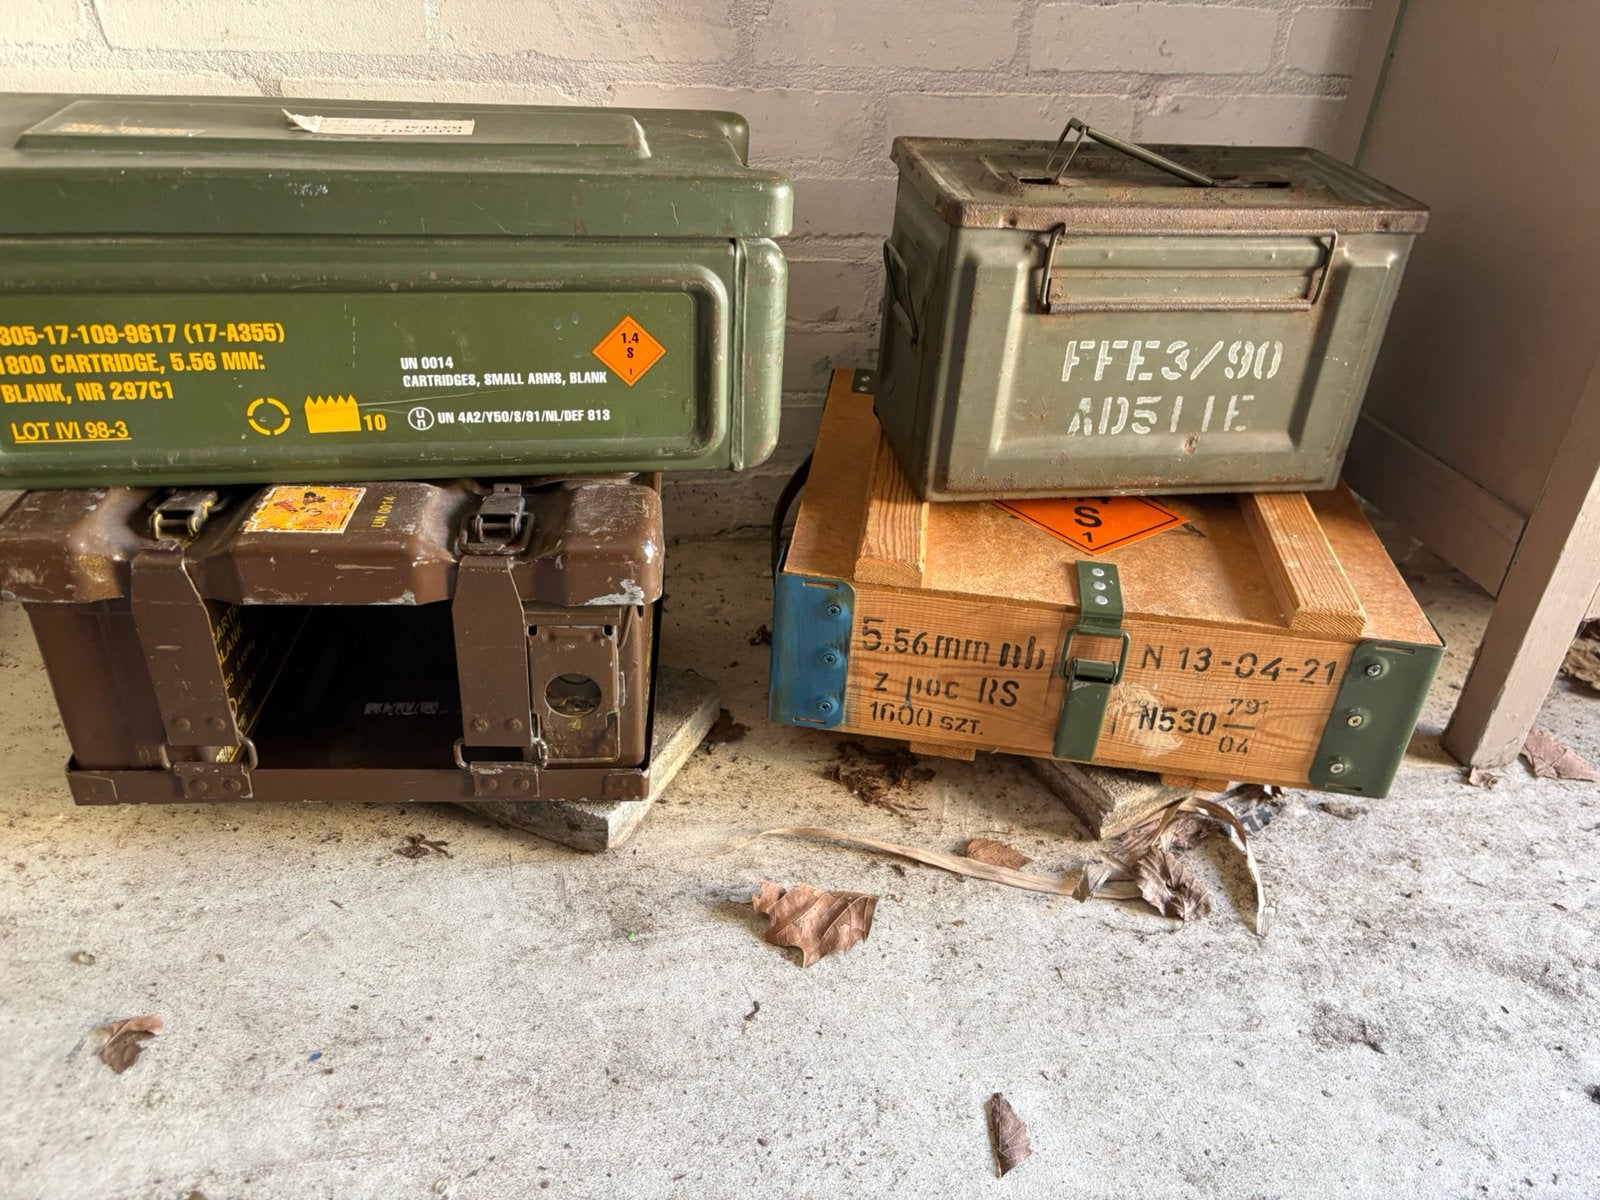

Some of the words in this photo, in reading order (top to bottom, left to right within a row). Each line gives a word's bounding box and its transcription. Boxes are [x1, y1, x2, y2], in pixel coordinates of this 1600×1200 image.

[184, 322, 285, 344] (17-A355)
[621, 332, 639, 344] 1.4
[50, 353, 165, 375] CARTRIDGE,
[169, 351, 217, 372] 5.56
[221, 351, 265, 370] MM:
[400, 357, 418, 370] UN
[421, 356, 454, 369] 0014
[626, 347, 634, 359] S
[1061, 340, 1284, 382] FFE3/90
[403, 373, 480, 388] CARTRIDGES,
[483, 373, 525, 386] SMALL
[528, 372, 566, 387] ARMS,
[569, 371, 607, 384] BLANK
[0, 382, 72, 405] BLANK,
[75, 381, 106, 401] NR
[109, 380, 174, 400] 297C1
[364, 413, 387, 431] 10
[437, 411, 455, 424] UN
[588, 409, 610, 421] 813
[11, 421, 49, 440] LOT
[84, 420, 128, 440] 98-3
[377, 495, 397, 514] 0014
[371, 515, 389, 528] UN
[1073, 505, 1103, 528] S
[1082, 531, 1093, 543] 1
[1141, 644, 1164, 670] N
[1178, 647, 1338, 686] 13-04-21
[978, 676, 1020, 707] RS
[870, 700, 933, 728] 1600
[1138, 704, 1218, 736] N530
[1218, 735, 1249, 755] 04
